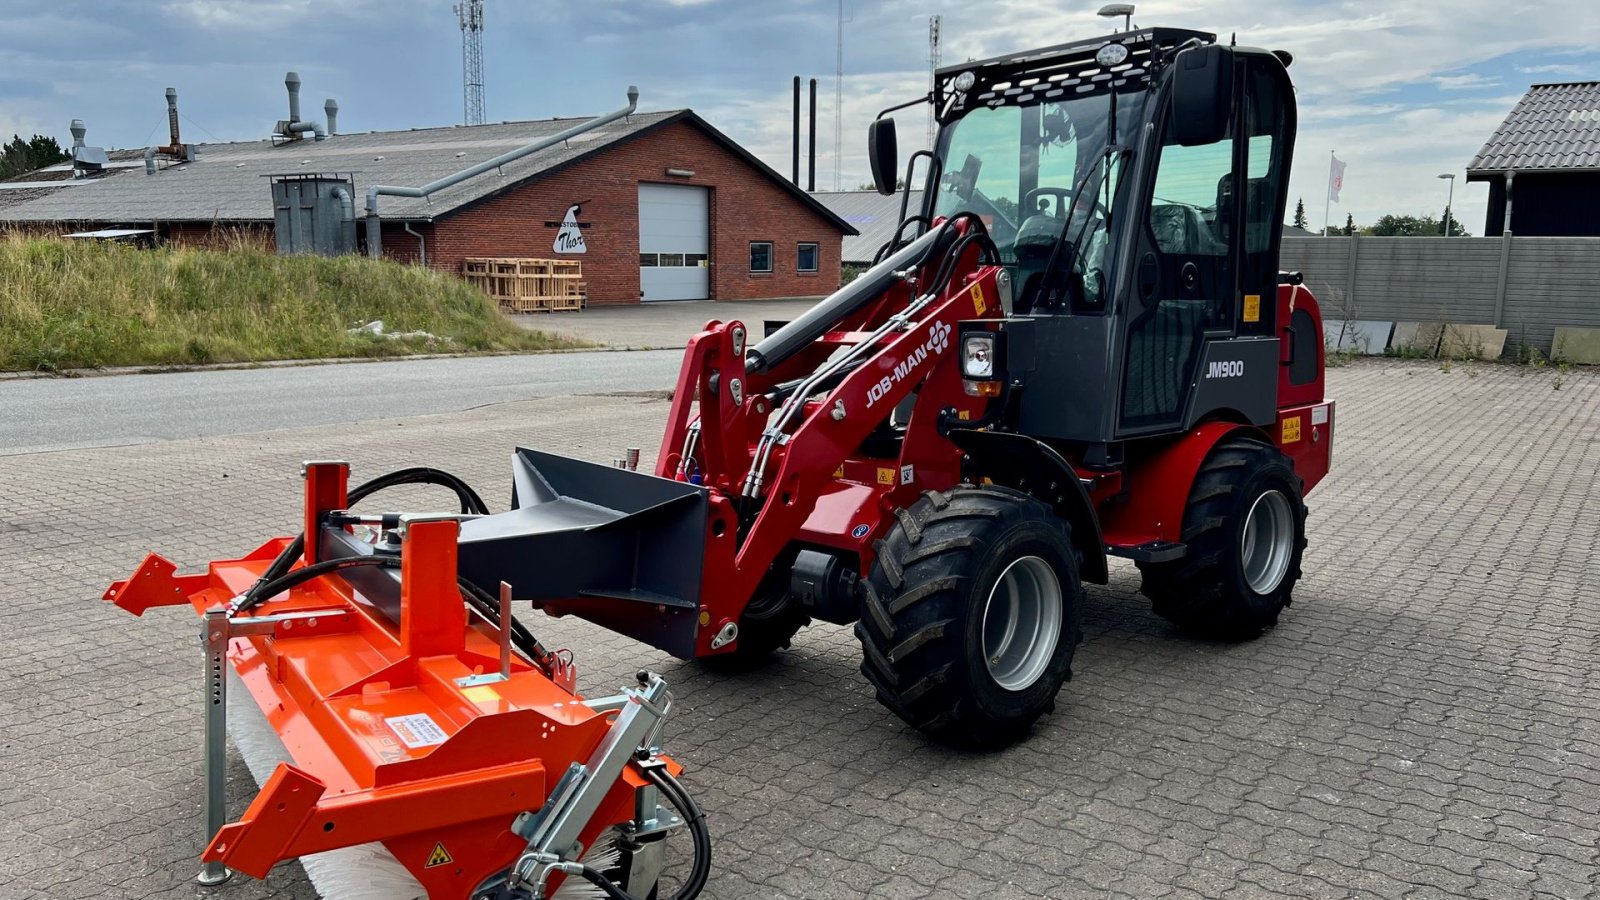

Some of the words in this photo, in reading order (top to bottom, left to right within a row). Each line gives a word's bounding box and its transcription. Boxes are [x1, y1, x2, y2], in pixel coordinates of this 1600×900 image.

[558, 231, 583, 251] Thor
[866, 344, 928, 408] JOB-MAN
[1206, 360, 1244, 378] JM900
